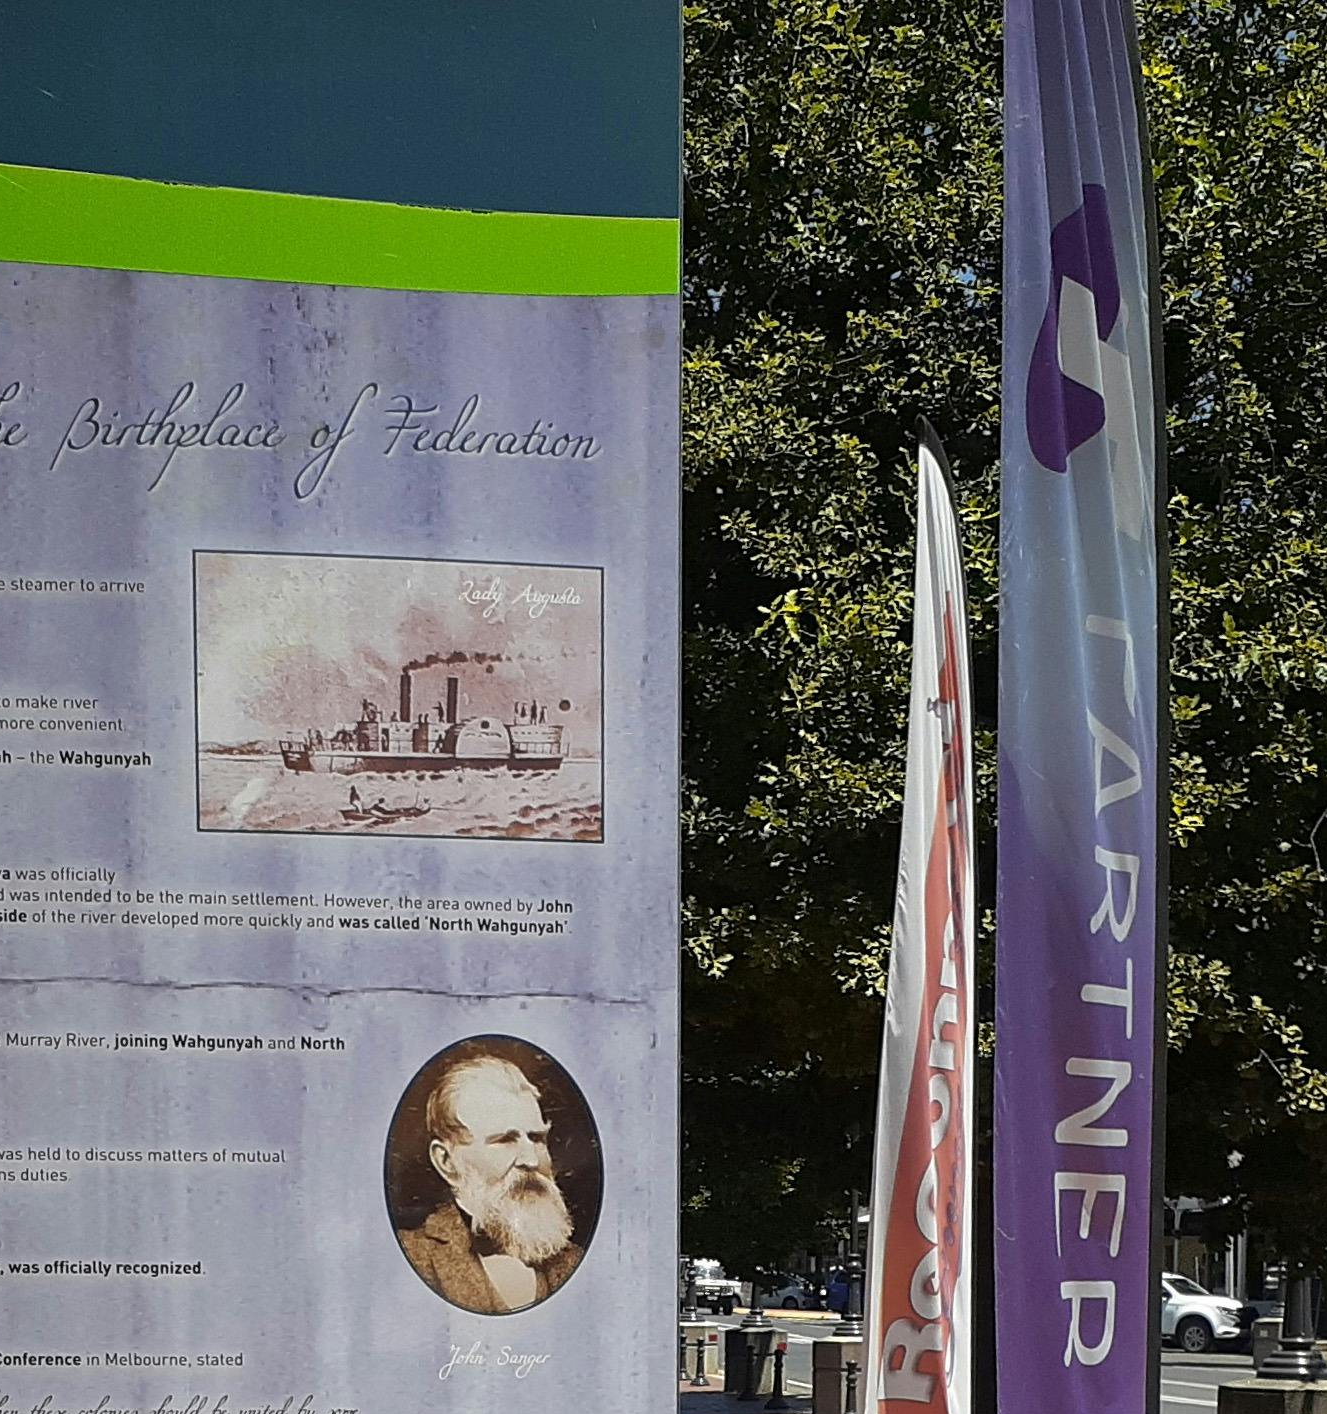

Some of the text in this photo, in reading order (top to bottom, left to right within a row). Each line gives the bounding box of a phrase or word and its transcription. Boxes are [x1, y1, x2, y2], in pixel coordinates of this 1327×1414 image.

[49, 381, 283, 492] Birthplace
[294, 381, 380, 500] of
[382, 392, 603, 462] Federation
[10, 578, 76, 592] steamer
[80, 577, 95, 592] to
[99, 580, 145, 593] arrive
[457, 579, 584, 618] Lady Augusta
[15, 694, 58, 709] make
[63, 697, 99, 709] river
[86, 1355, 100, 1366] in
[105, 1351, 192, 1367] Melbourne,
[196, 1352, 243, 1366] stated
[438, 1340, 552, 1381] John Sanger
